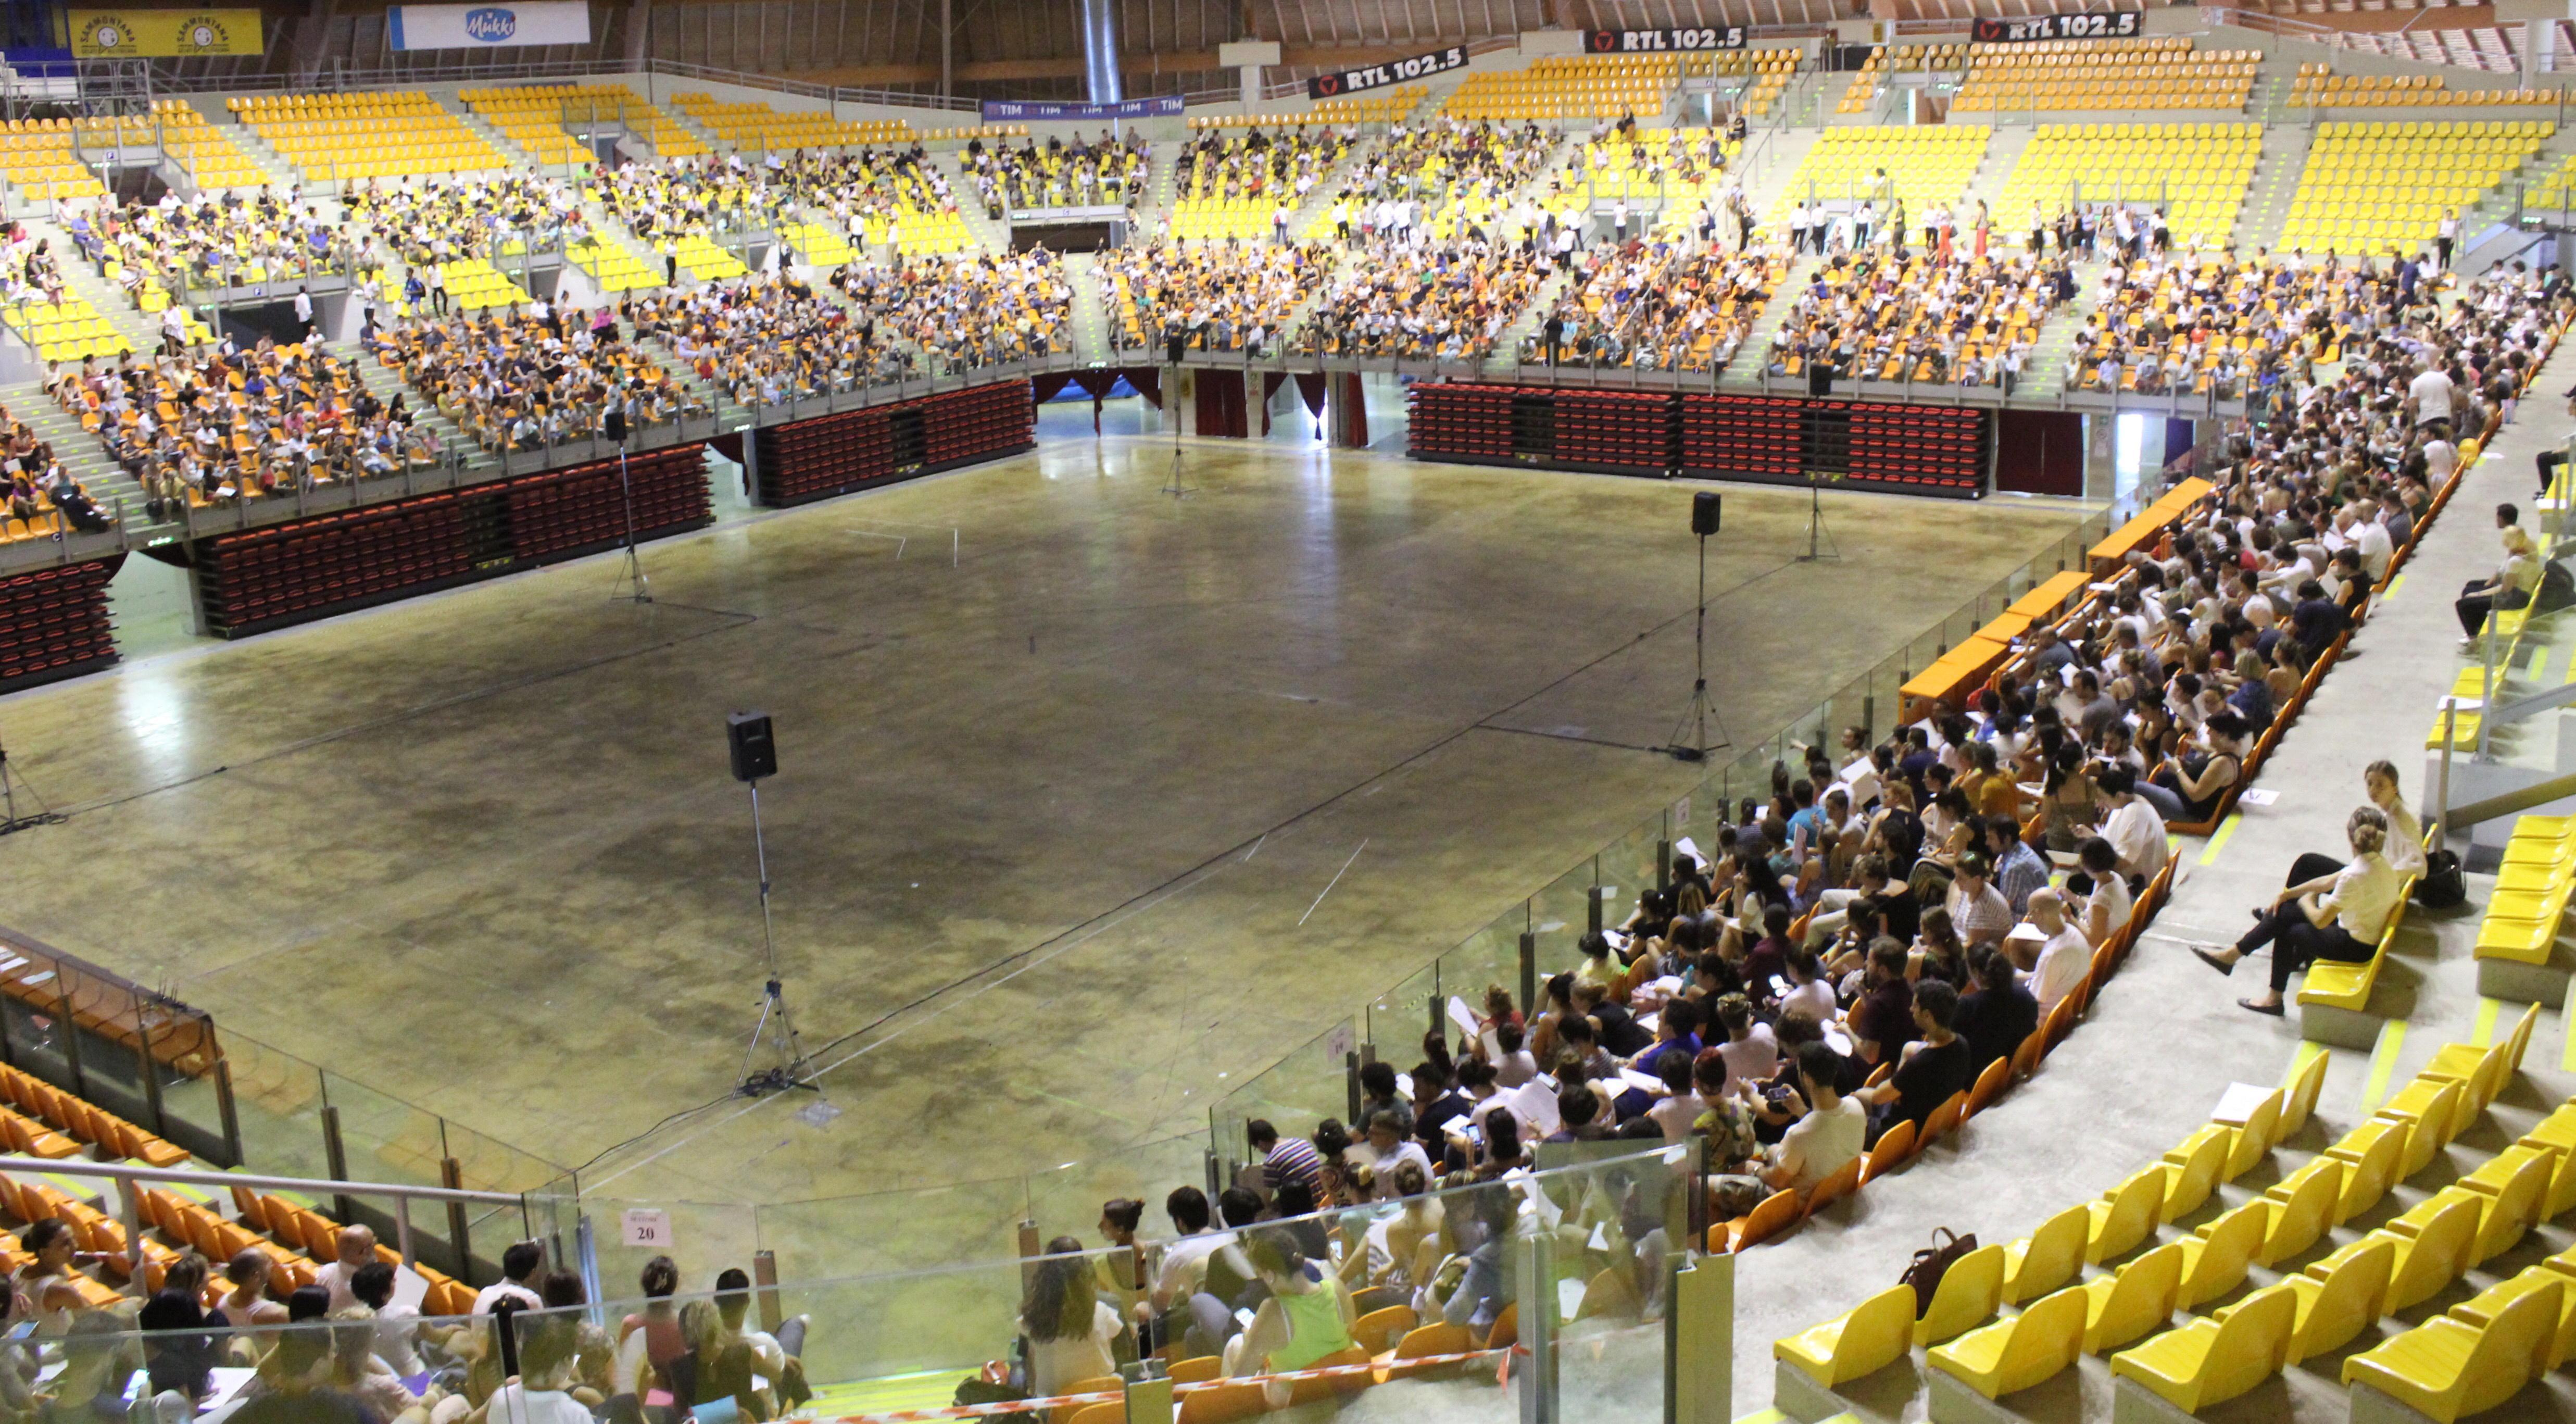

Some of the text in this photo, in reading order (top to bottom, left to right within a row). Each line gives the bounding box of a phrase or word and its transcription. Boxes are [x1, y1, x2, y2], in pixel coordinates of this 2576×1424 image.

[2009, 14, 2135, 40] RTL 102.5
[1623, 28, 1742, 51] RTL 102.5
[1347, 48, 1462, 90] RTL 102.5
[1000, 105, 1022, 115] TIM
[1161, 99, 1183, 111] TIM
[637, 1227, 655, 1240] 20
